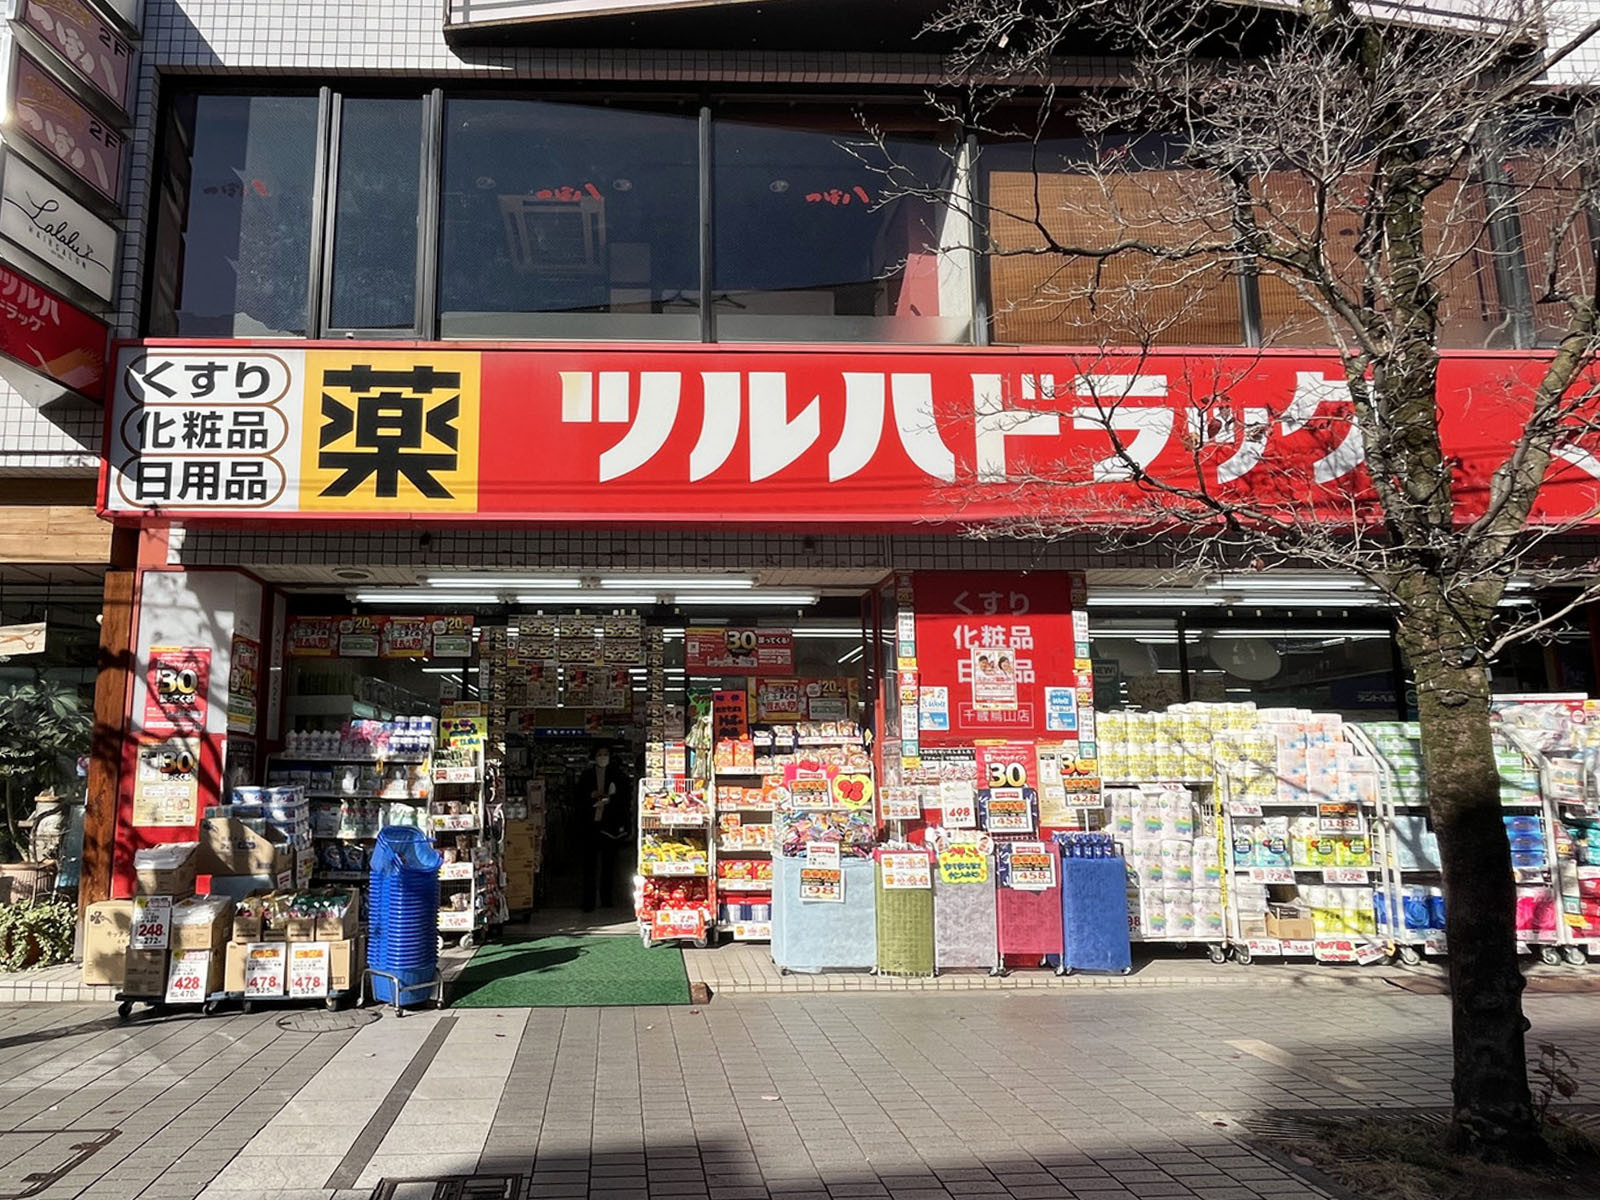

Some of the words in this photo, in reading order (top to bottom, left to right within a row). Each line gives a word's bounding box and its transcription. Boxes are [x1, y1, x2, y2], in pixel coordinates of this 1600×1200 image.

[98, 27, 127, 58] 2F
[89, 120, 118, 149] 2F
[141, 361, 271, 398] くすり
[136, 410, 268, 450] 化粧品
[317, 364, 461, 499] 薬
[135, 461, 268, 500] 日用品
[953, 591, 1031, 615] くすり
[727, 631, 758, 650] 30
[953, 624, 1034, 650] 化粧品
[158, 669, 198, 694] 30
[957, 658, 1036, 684] 日品
[160, 751, 195, 774] 30
[989, 762, 1027, 788] 30
[838, 780, 864, 802] 98
[1019, 872, 1047, 880] 458
[138, 923, 163, 937] 248
[144, 937, 159, 945] 272
[174, 976, 200, 990] 428
[249, 976, 276, 988] 478
[294, 976, 321, 988] 478
